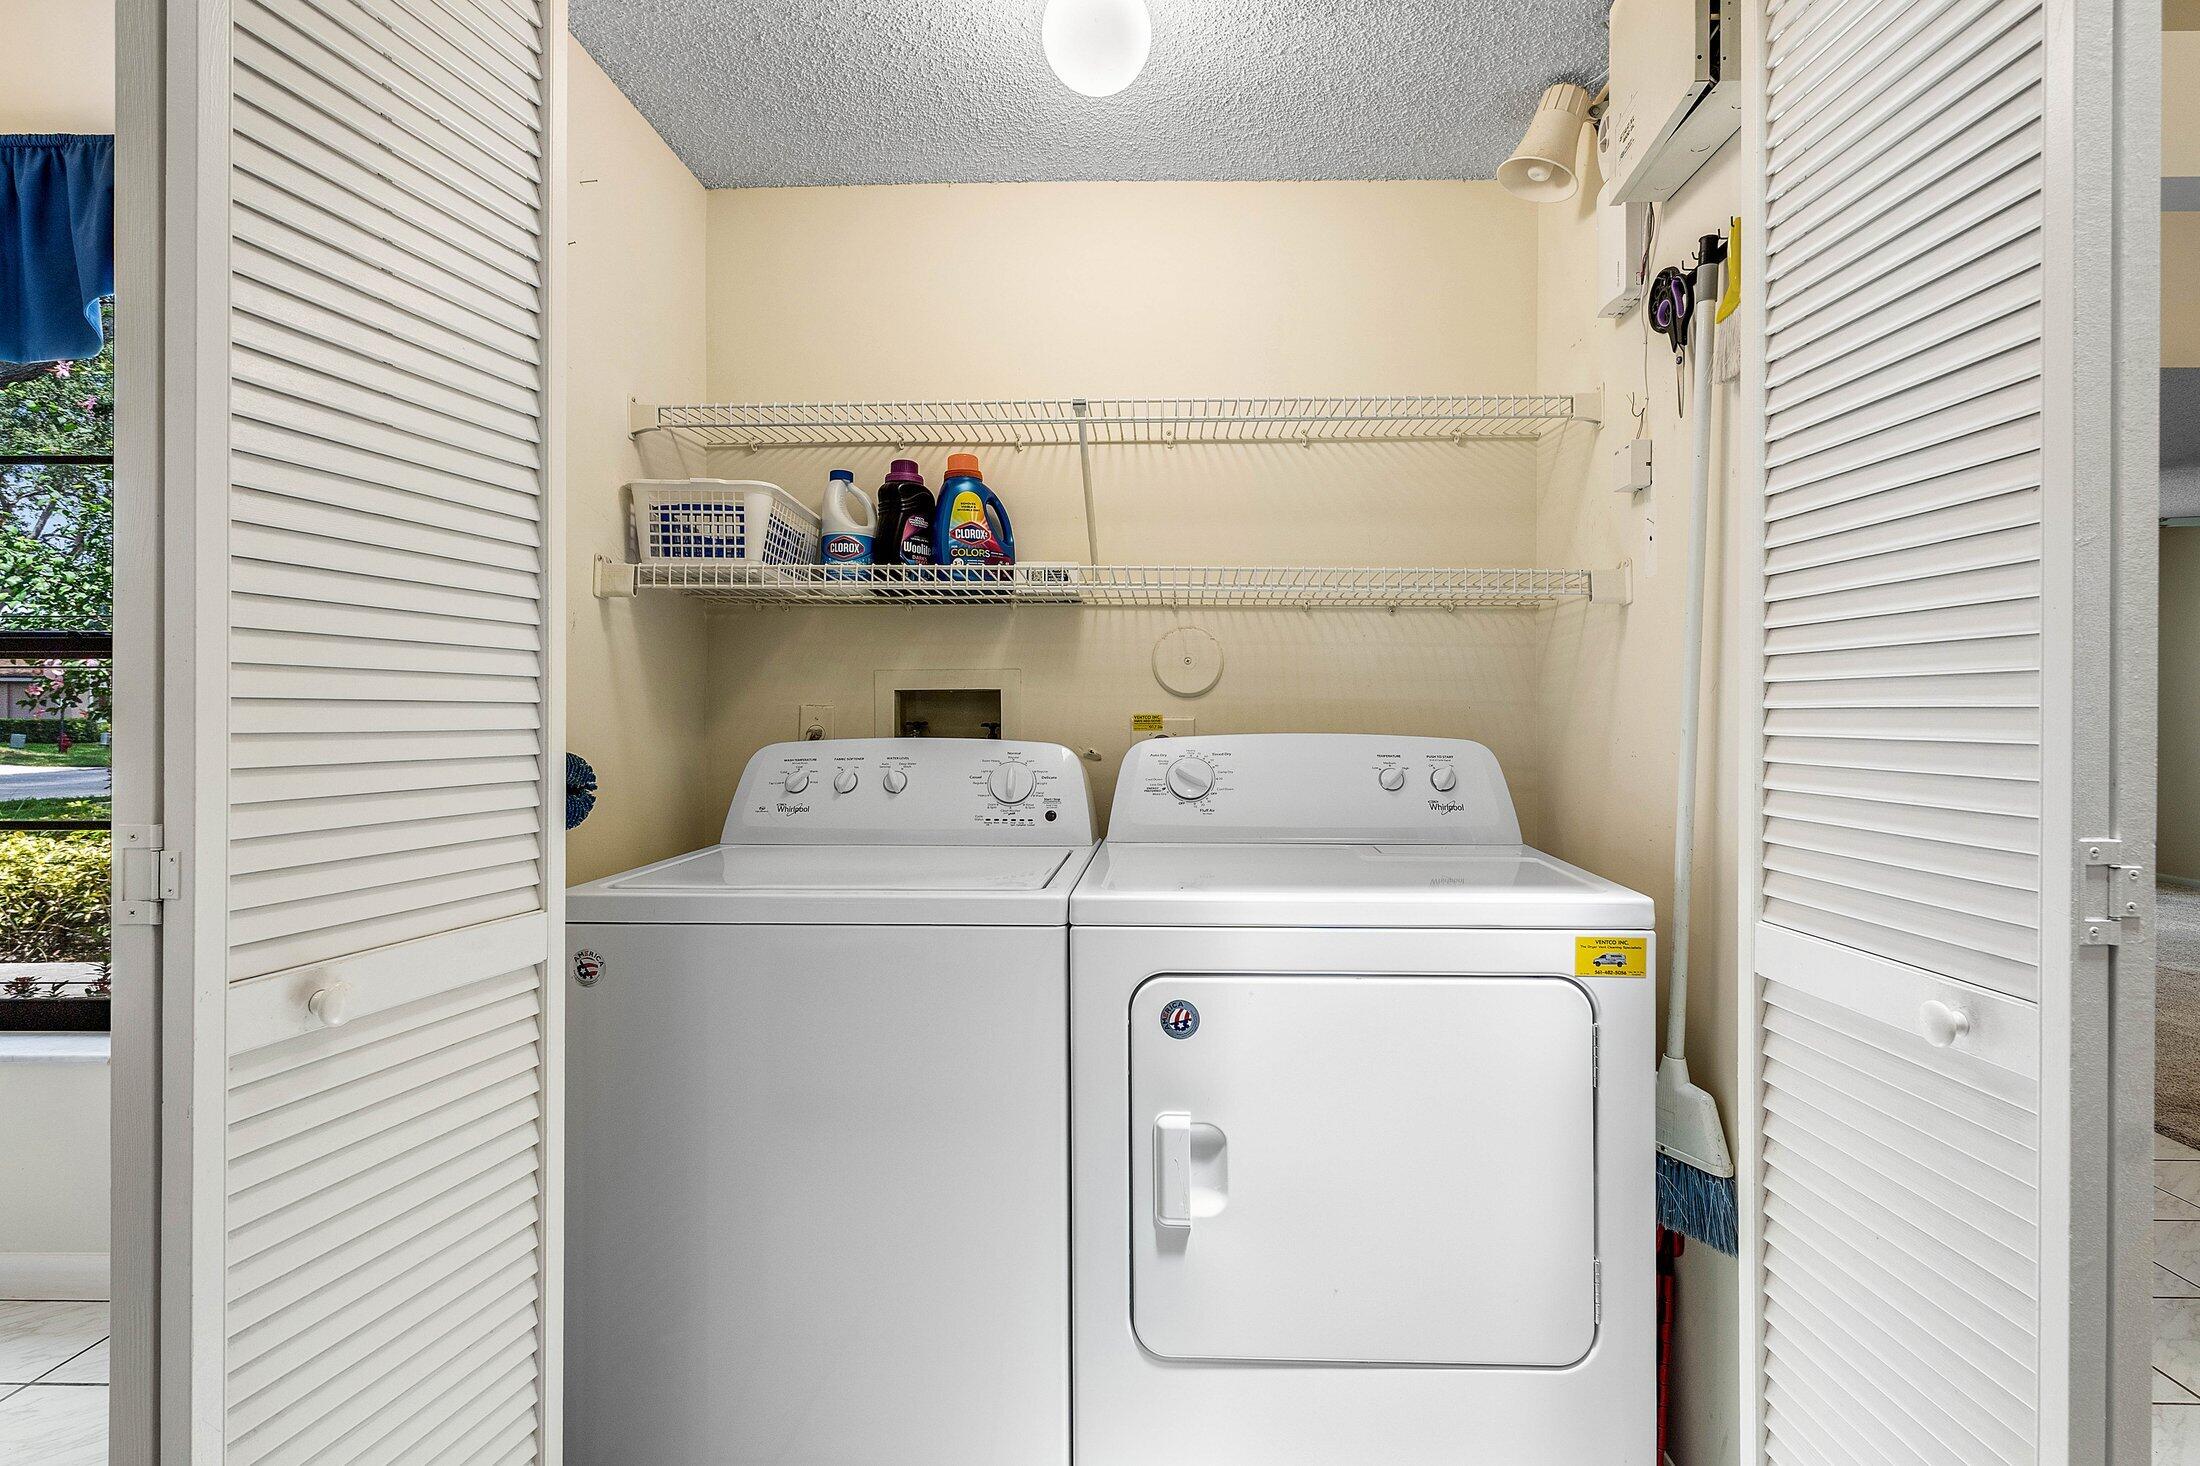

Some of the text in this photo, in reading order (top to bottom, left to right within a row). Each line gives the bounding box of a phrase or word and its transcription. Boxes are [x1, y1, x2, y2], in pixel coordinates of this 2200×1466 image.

[830, 542, 860, 553] CLOROX
[950, 548, 991, 558] COLORS
[776, 804, 811, 813] Whirlpool
[1428, 802, 1465, 812] Whirlpool
[573, 950, 605, 967] AMERICA
[1160, 1001, 1184, 1030] AMERICA
